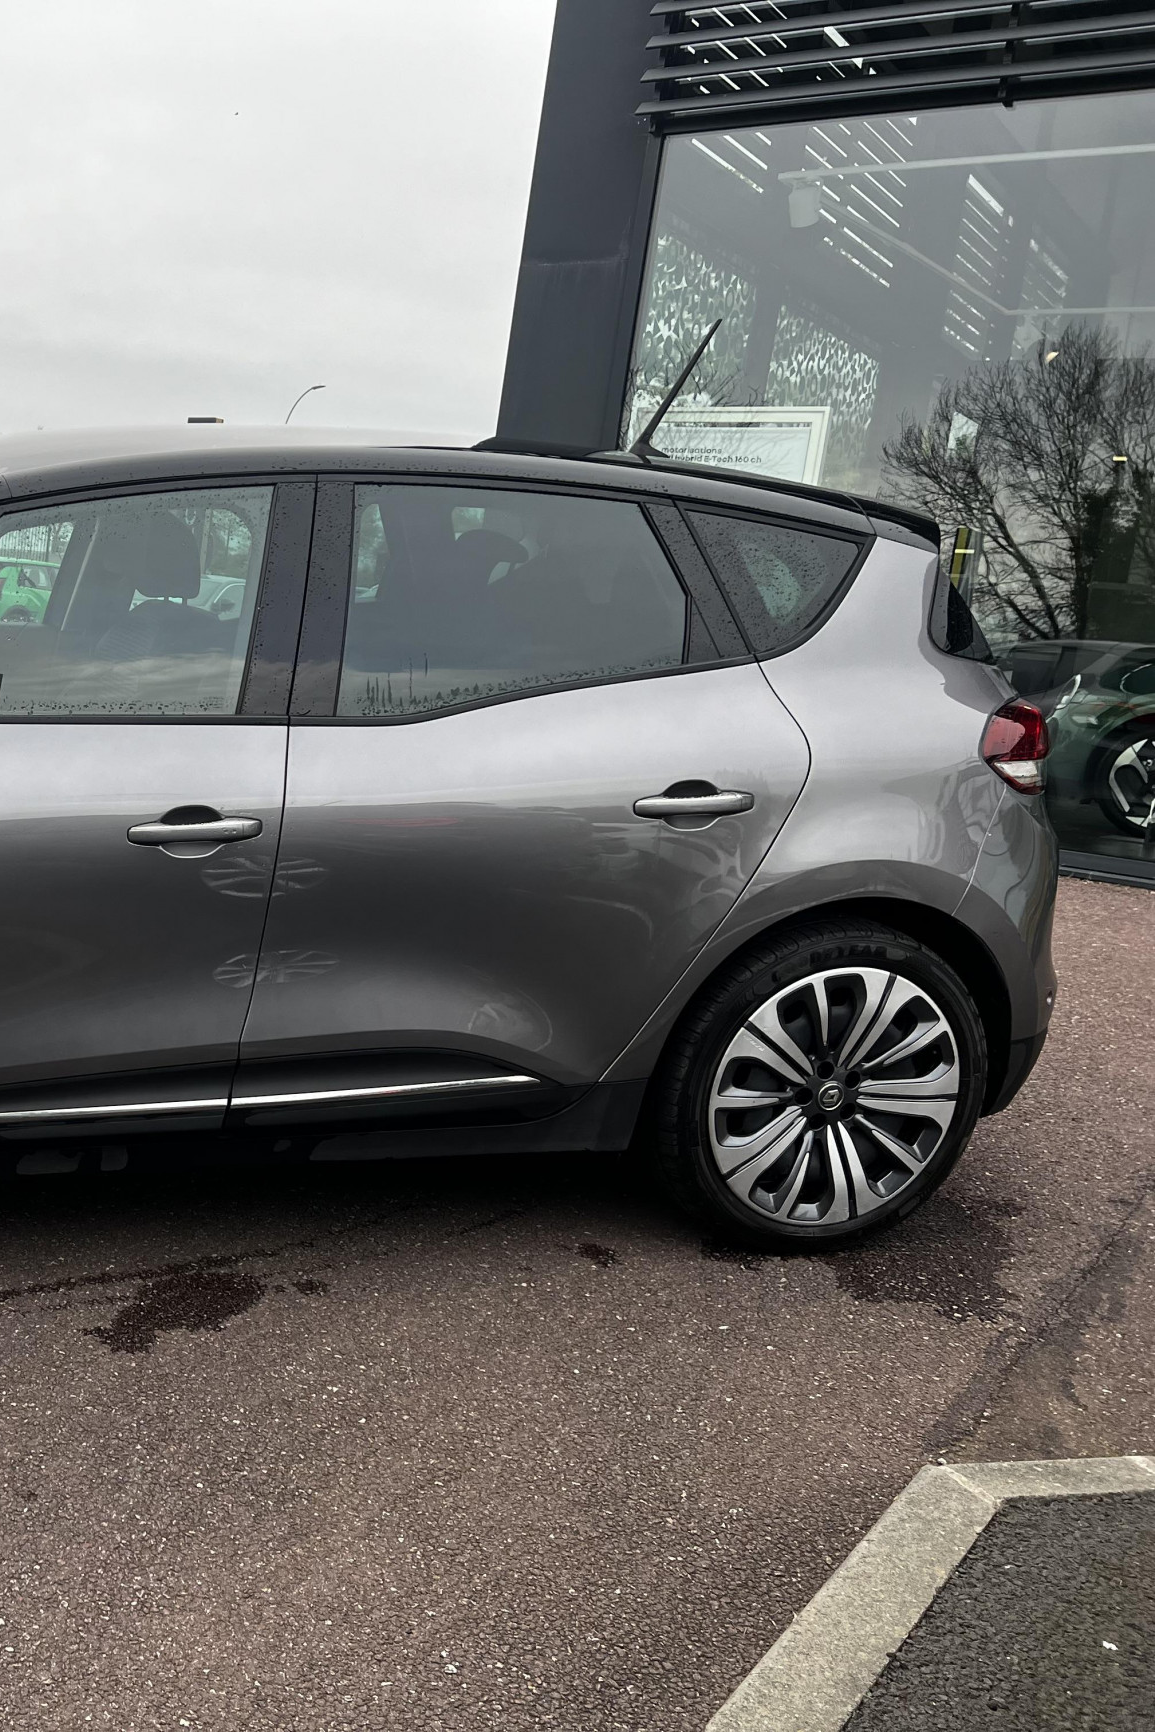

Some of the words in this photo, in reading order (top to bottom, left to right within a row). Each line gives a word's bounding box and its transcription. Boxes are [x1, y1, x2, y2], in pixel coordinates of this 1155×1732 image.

[661, 446, 722, 454] motorisations
[704, 455, 733, 463] E-Tech
[735, 455, 749, 463] 160
